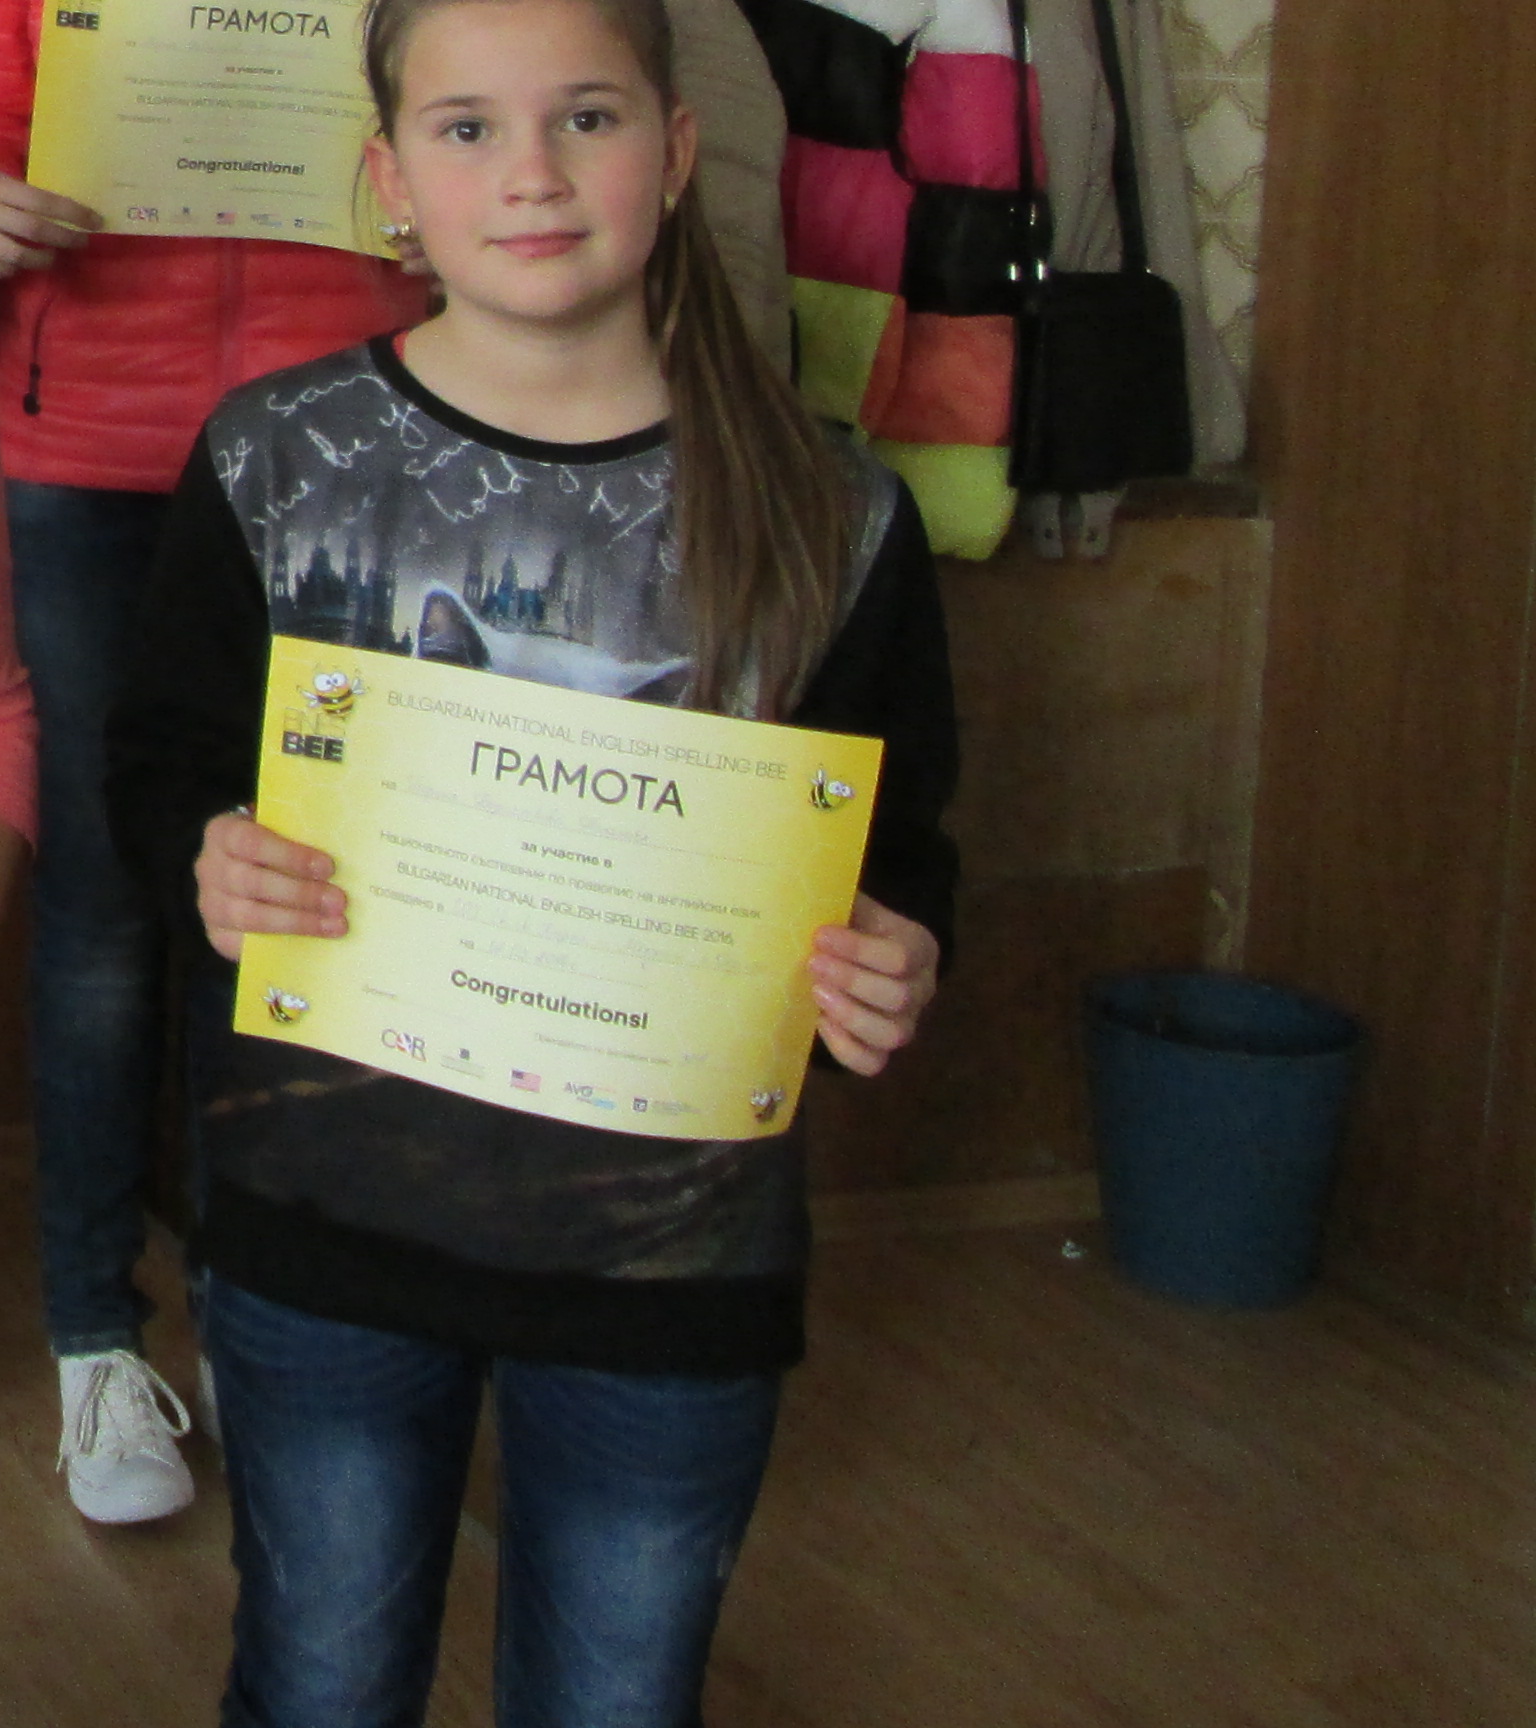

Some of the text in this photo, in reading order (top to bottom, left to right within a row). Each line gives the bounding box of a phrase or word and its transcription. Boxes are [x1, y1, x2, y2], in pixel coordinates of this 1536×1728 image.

[56, 9, 100, 31] BEE
[189, 5, 331, 39] ГРАМОТА
[176, 157, 305, 177] Congratulations!
[281, 730, 345, 763] BEE
[388, 690, 789, 781] BULGARIAN NATIONAL ENGLISH SPELLING BEE
[470, 740, 684, 817] ГРАМОТА
[541, 843, 600, 867] участие
[604, 858, 613, 869] в
[450, 968, 649, 1030] Congratulations!
